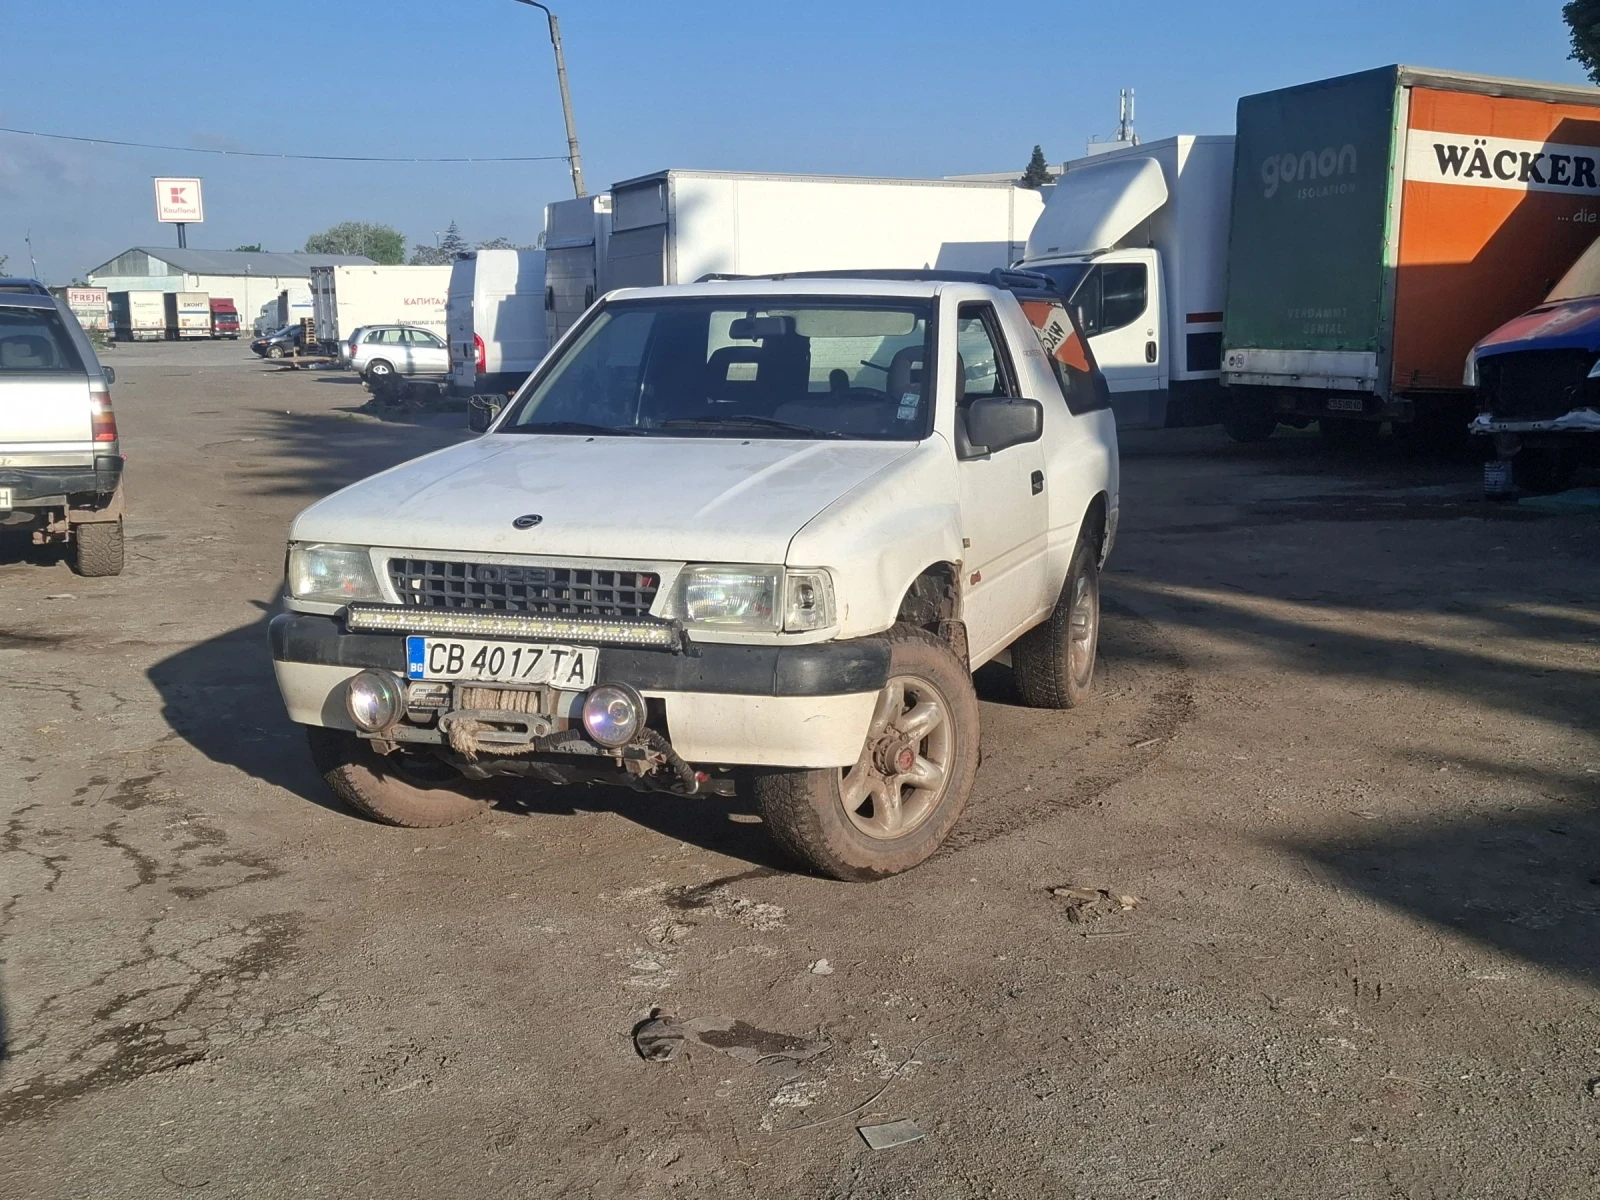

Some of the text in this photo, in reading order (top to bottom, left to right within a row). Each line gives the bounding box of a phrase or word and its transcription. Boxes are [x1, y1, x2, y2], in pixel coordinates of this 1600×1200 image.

[1261, 143, 1357, 198] gonon
[1433, 138, 1600, 188] WÄCKER
[1297, 183, 1356, 199] ISOLATION
[163, 206, 197, 214] Kaufland
[1573, 208, 1597, 223] die
[73, 294, 102, 303] FREJA
[1287, 307, 1348, 319] VERDAMMT
[476, 565, 569, 588] OPEL
[410, 662, 423, 673] BG
[428, 643, 585, 685] CB 4017 TA
